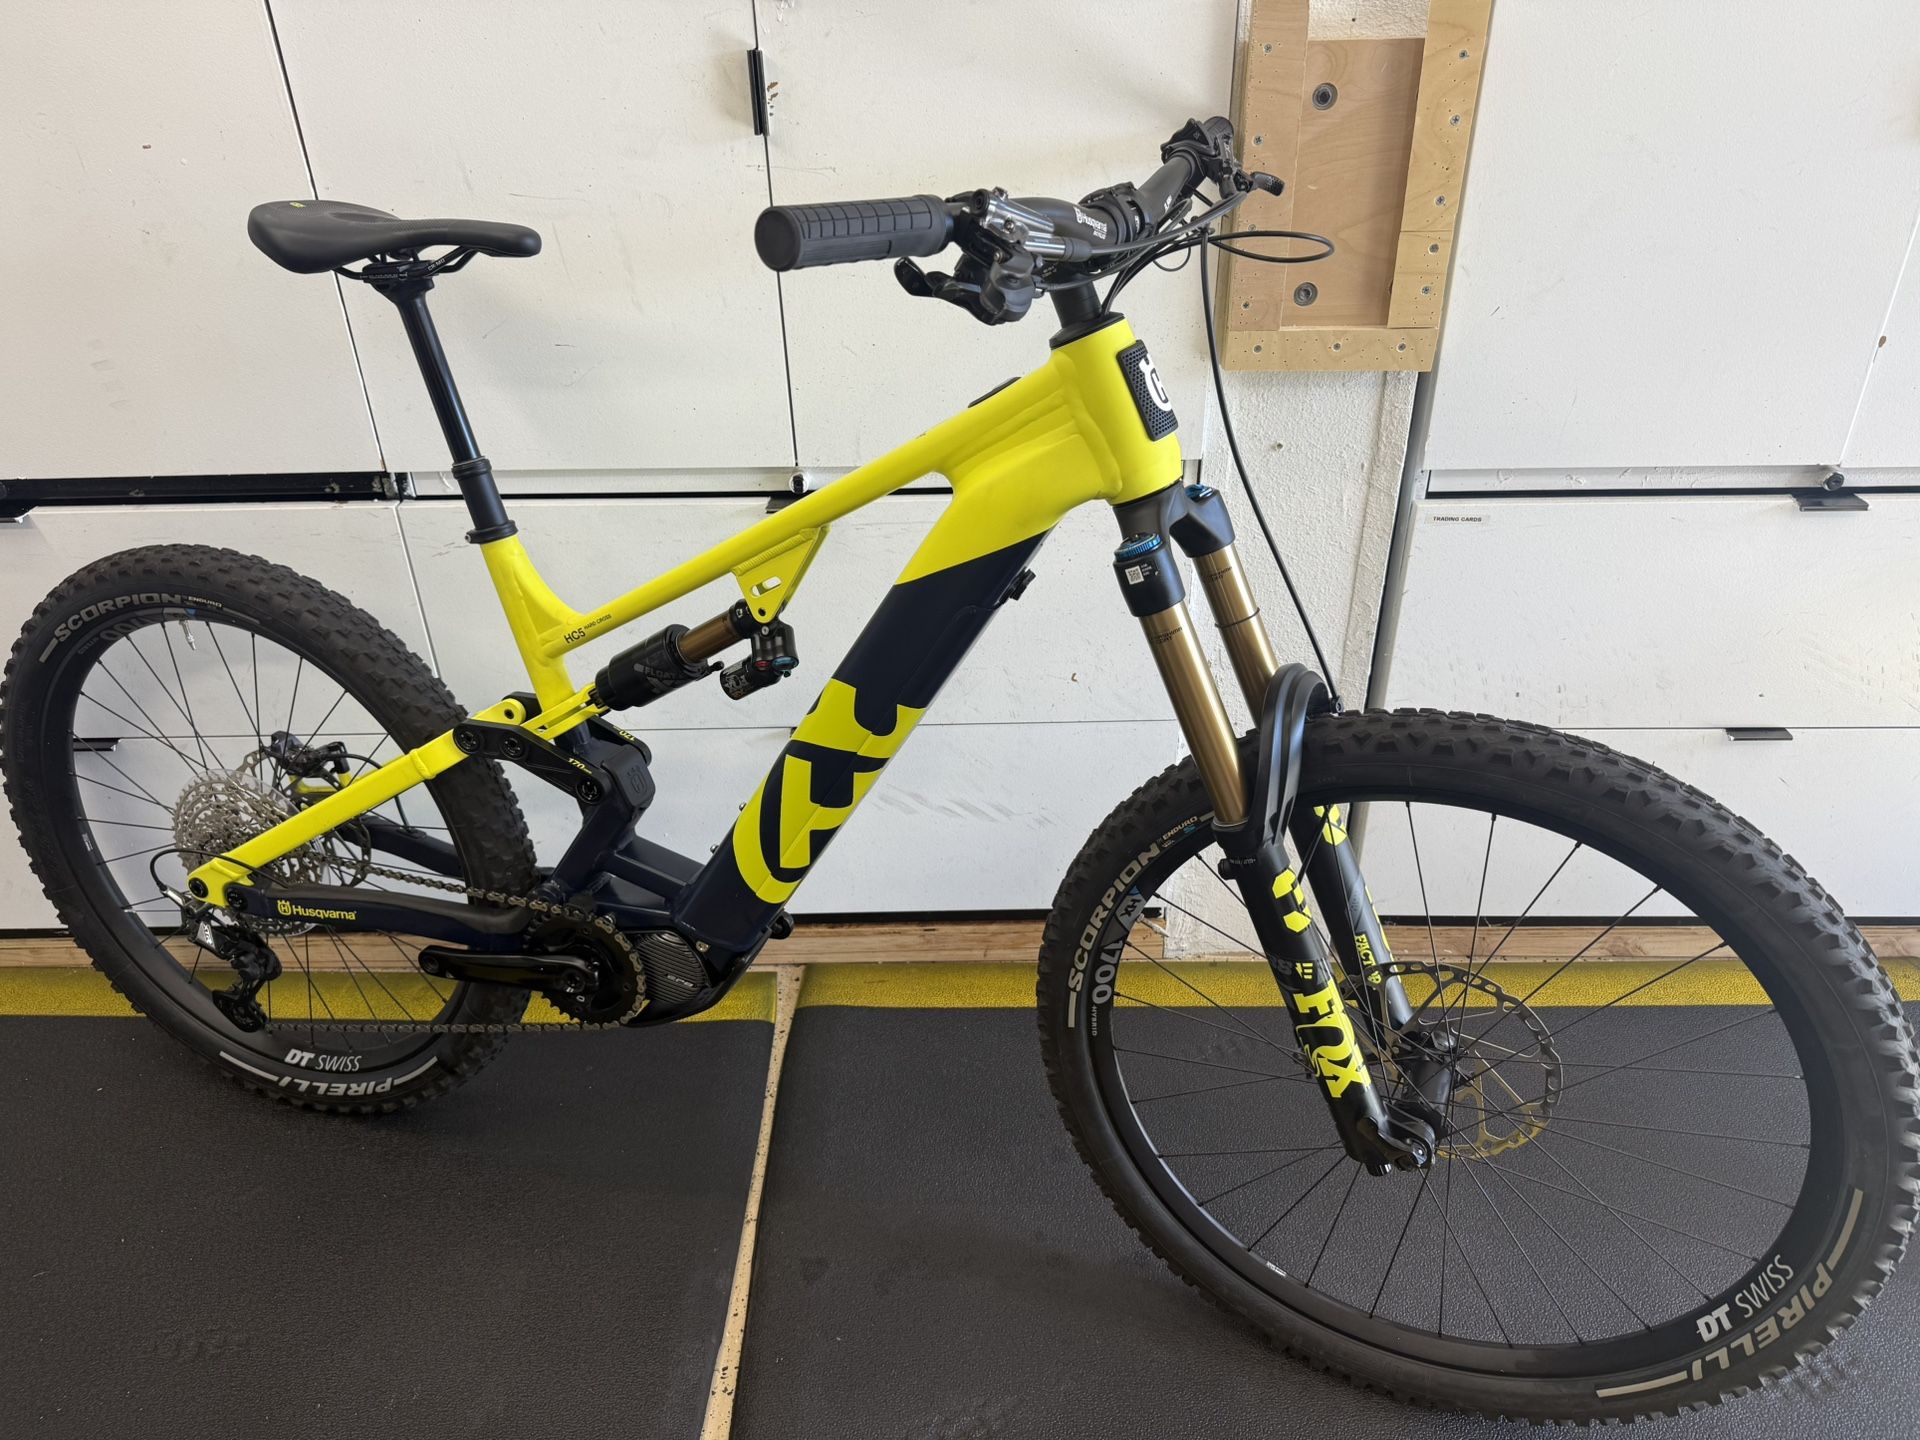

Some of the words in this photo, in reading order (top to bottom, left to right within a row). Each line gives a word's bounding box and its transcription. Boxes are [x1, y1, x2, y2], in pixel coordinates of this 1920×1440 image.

[54, 592, 182, 642] SCORPION
[563, 629, 586, 644] HC5
[293, 904, 357, 920] Husqvarna
[1067, 842, 1161, 993] SCORPION
[1162, 815, 1199, 841] ENDURO
[1091, 939, 1123, 1005] 1700
[284, 1048, 316, 1068] DT
[315, 1054, 362, 1072] SWISS
[1292, 978, 1372, 1099] FOX
[278, 1075, 393, 1097] PIRELLI
[1691, 1262, 1833, 1382] PIRELLI
[1696, 1303, 1733, 1343] DT
[1735, 1253, 1794, 1319] SWISS
